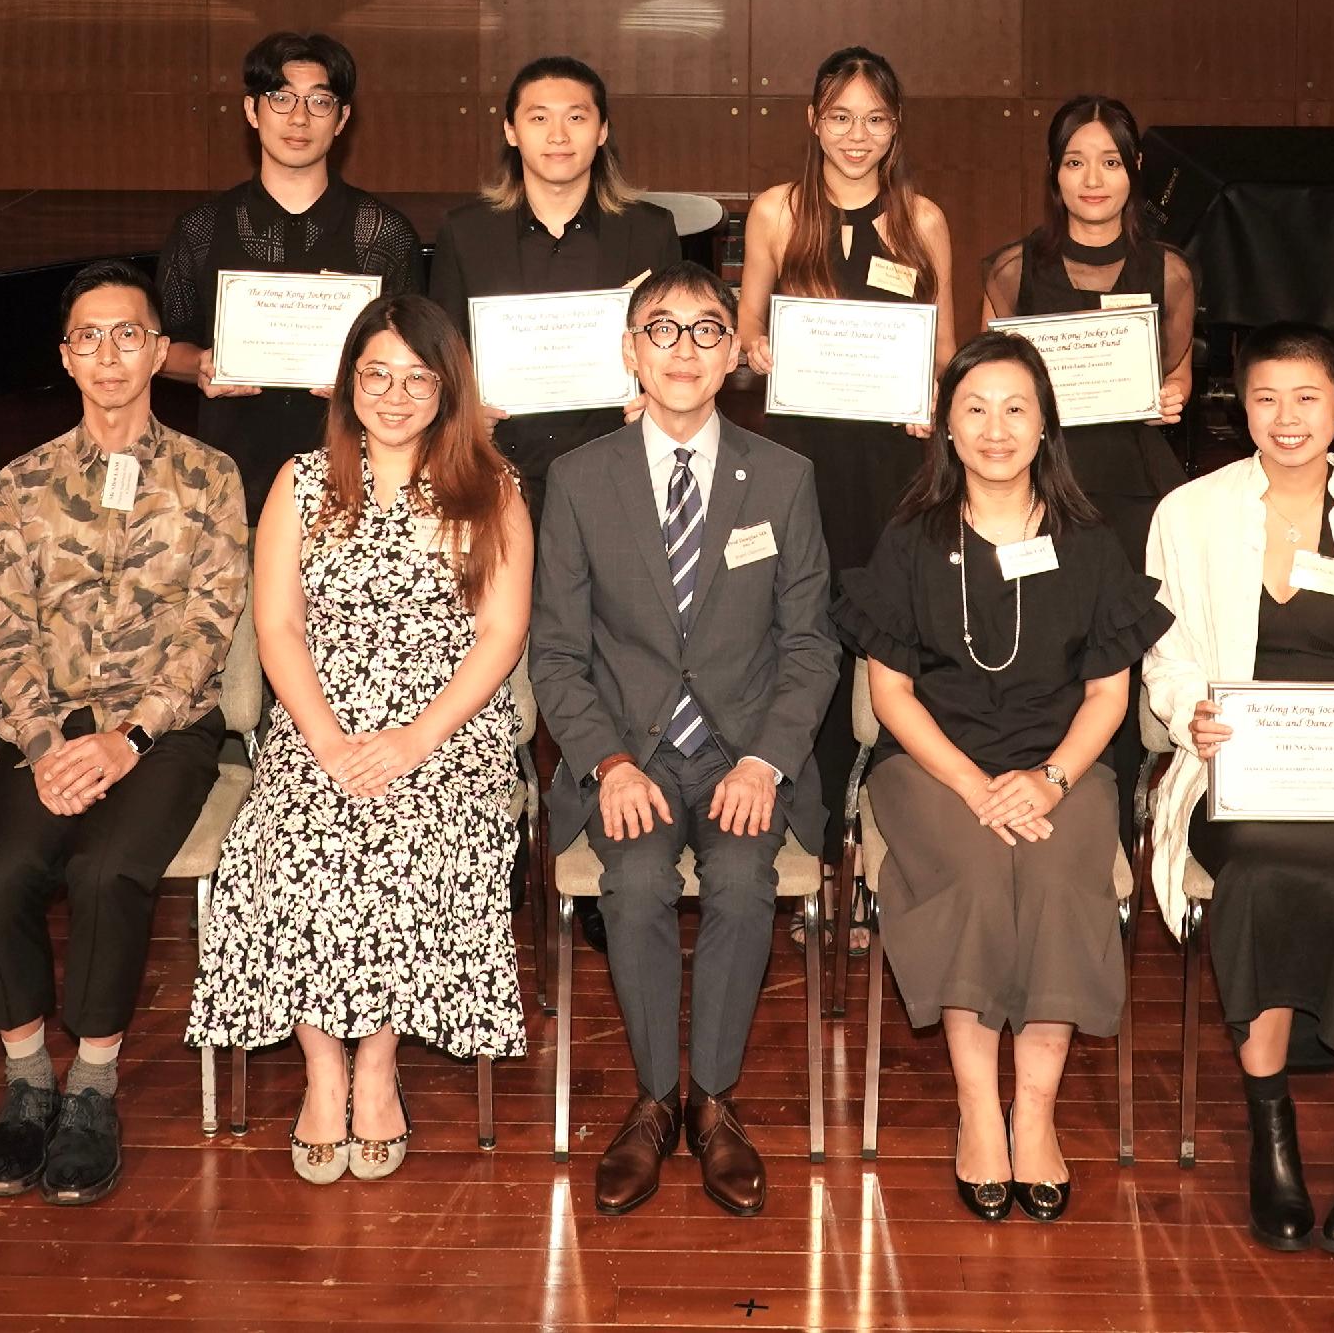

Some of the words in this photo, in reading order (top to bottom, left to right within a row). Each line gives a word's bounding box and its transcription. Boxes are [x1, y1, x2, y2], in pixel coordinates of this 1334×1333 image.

[1246, 704, 1262, 713] The
[1263, 705, 1289, 716] Hong
[1291, 705, 1316, 716] Kong
[1255, 719, 1284, 727] Music
[1285, 717, 1303, 727] and
[1305, 719, 1333, 727] Dance
